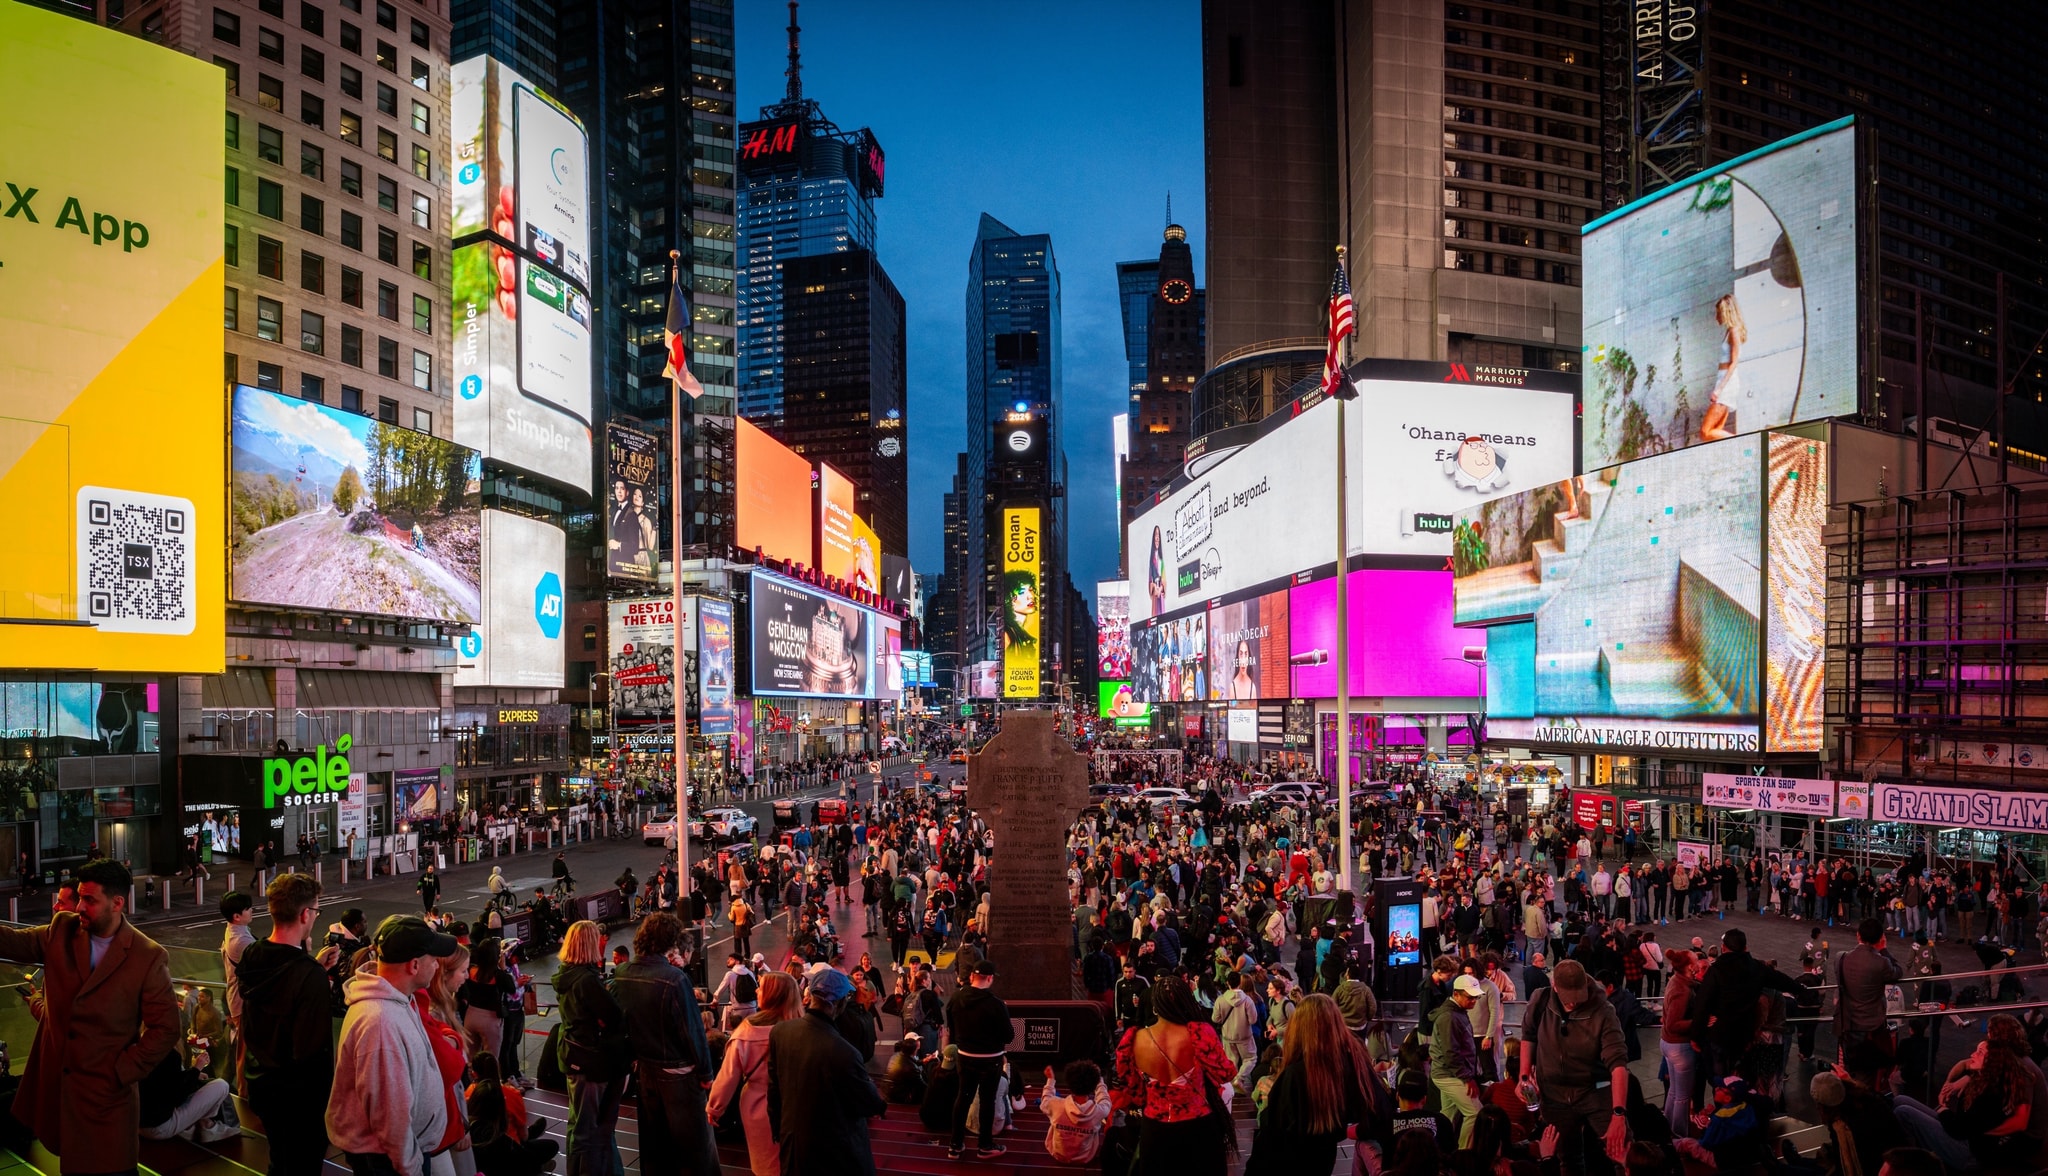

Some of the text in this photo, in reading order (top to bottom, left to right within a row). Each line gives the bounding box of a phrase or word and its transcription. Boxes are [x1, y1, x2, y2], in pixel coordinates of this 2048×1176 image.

[742, 124, 797, 160] H&M
[554, 203, 576, 223] Arming
[55, 196, 150, 254] App
[464, 302, 481, 366] Simpler
[1475, 366, 1529, 377] MARRIOTT
[1475, 374, 1524, 385] MARQUIS
[506, 407, 571, 452] Simpler
[1480, 432, 1537, 447] means
[1434, 449, 1454, 463] fa
[1233, 475, 1271, 508] beyond.
[1213, 497, 1229, 518] and
[1419, 516, 1451, 529] hulu
[1007, 514, 1021, 563] Conan
[1021, 526, 1038, 563] Gray
[127, 555, 150, 568] TSX
[1179, 570, 1194, 588] hulu
[539, 593, 561, 618] ADT
[628, 601, 674, 614] BEST O
[622, 612, 687, 626] THE YEA!
[787, 613, 791, 622] A
[768, 619, 808, 642] GENTLEMAN
[1220, 624, 1270, 646] URBAN DECAY
[773, 639, 808, 660] MOSCOW
[499, 710, 539, 723] EXPRESS
[591, 736, 674, 745] GIFT LUGGAGE
[1534, 726, 1758, 752] AMERICAN EAGLE OUTFITTERS
[263, 733, 353, 809] pelé
[1735, 776, 1797, 790] SPORTS FAN SHOP
[185, 804, 196, 812] THE
[284, 792, 340, 807] SOCCER
[1883, 787, 1970, 824] GRAND
[1030, 1025, 1054, 1033] TIMES
[1393, 1117, 1436, 1128] BIG MOOSE
